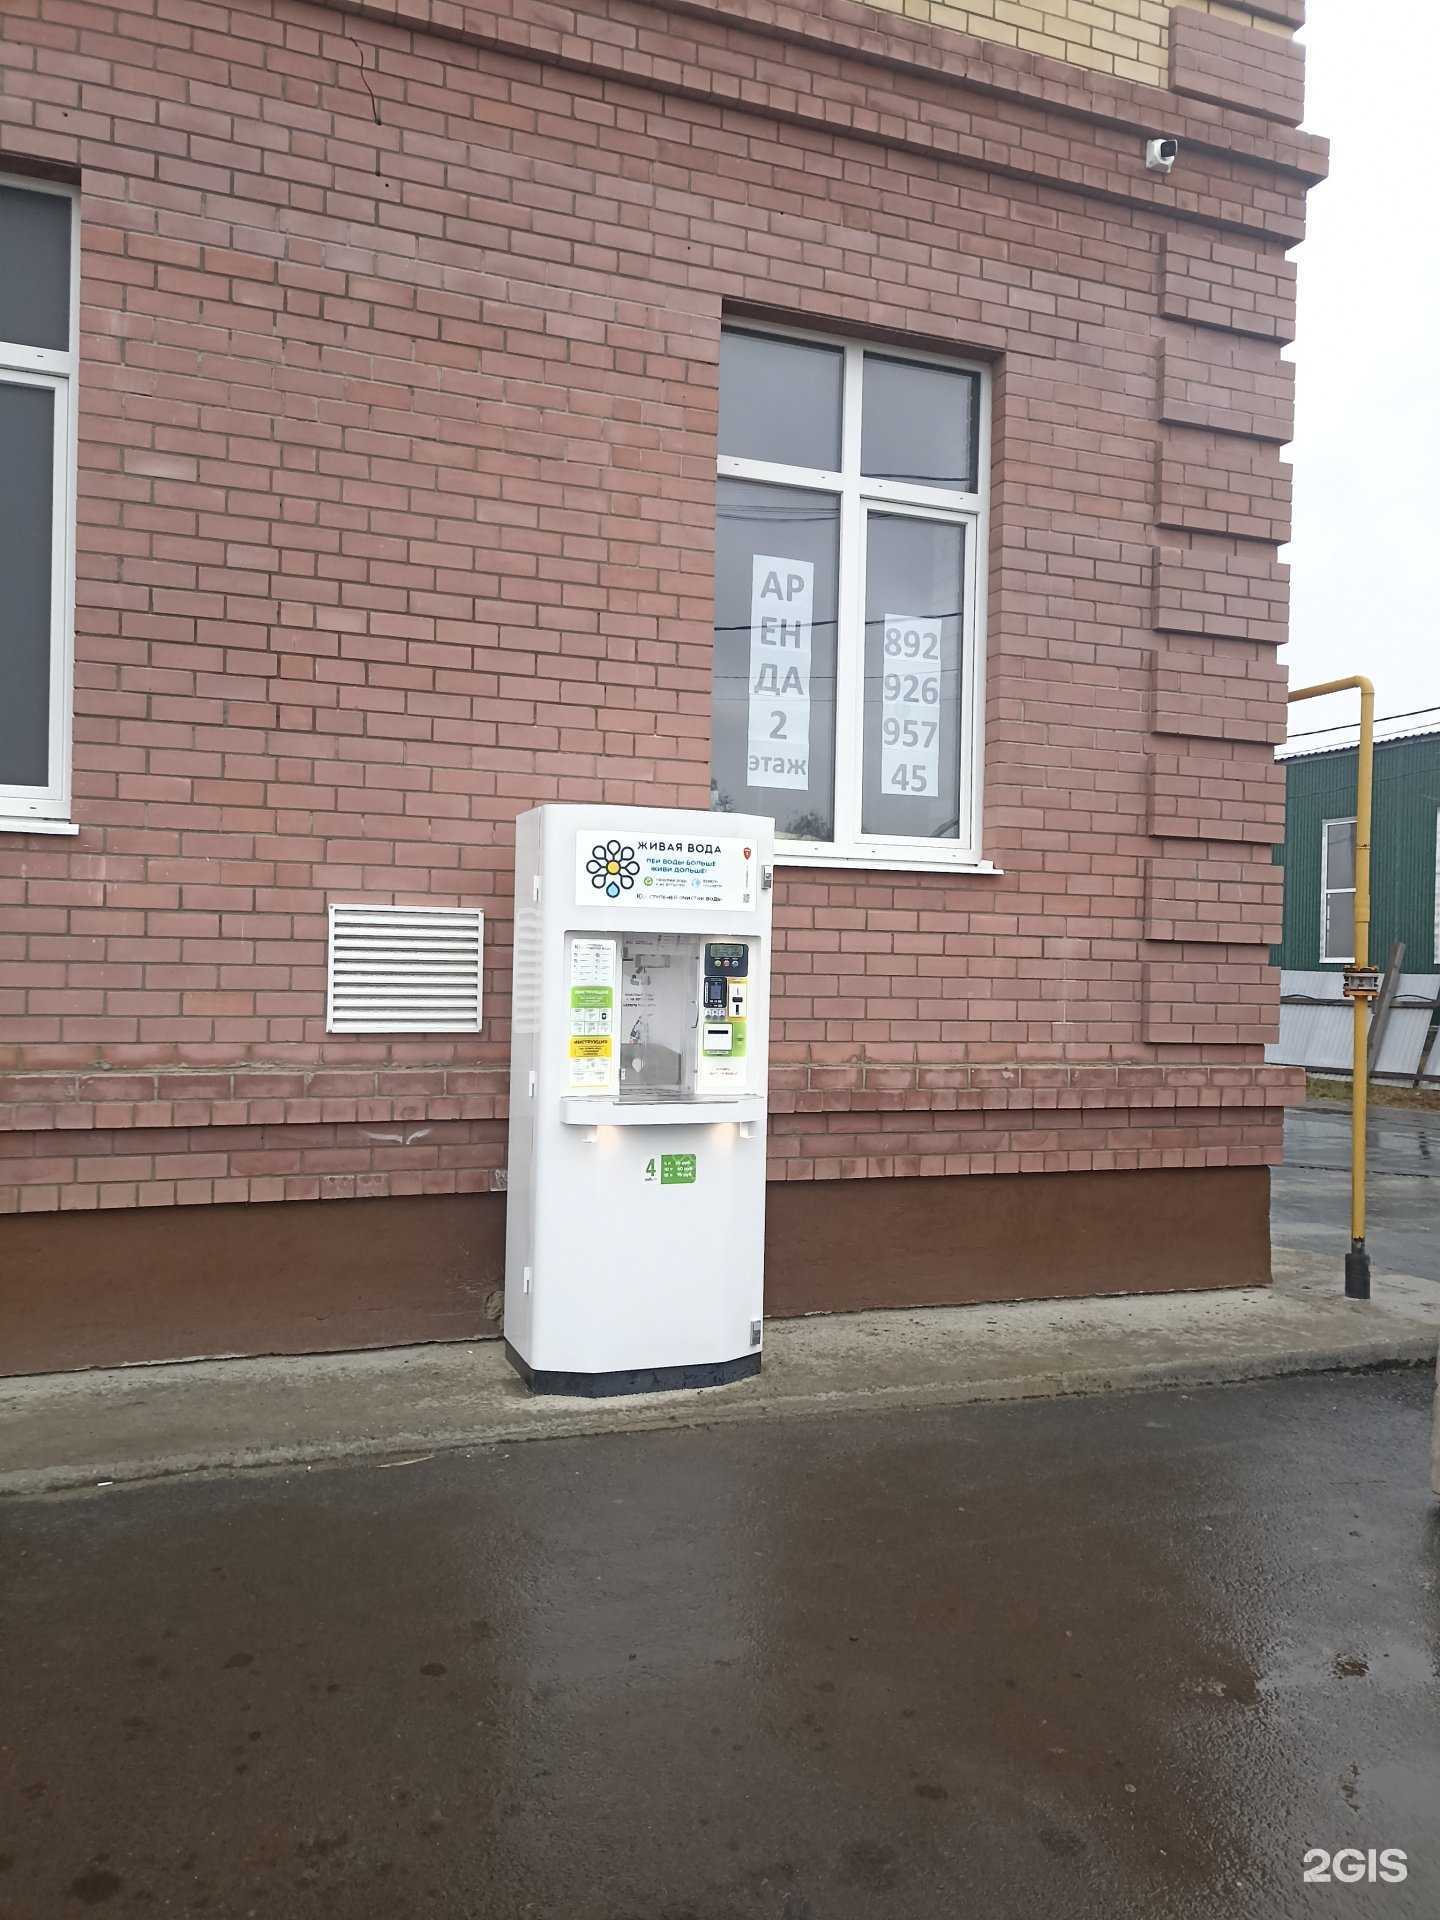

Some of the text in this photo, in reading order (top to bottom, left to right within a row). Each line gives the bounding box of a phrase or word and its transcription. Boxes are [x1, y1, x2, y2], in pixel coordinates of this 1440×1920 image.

[760, 571, 805, 602] АР
[760, 616, 801, 648] ЕН
[884, 627, 939, 660] 892
[754, 663, 804, 696] ДА
[884, 673, 939, 705] 926
[769, 710, 788, 740] 2
[883, 717, 938, 748] 957
[748, 754, 807, 776] этаж
[891, 763, 927, 792] 45
[637, 841, 721, 854] ЖИВАЯ ВОДА
[645, 1158, 657, 1177] 4
